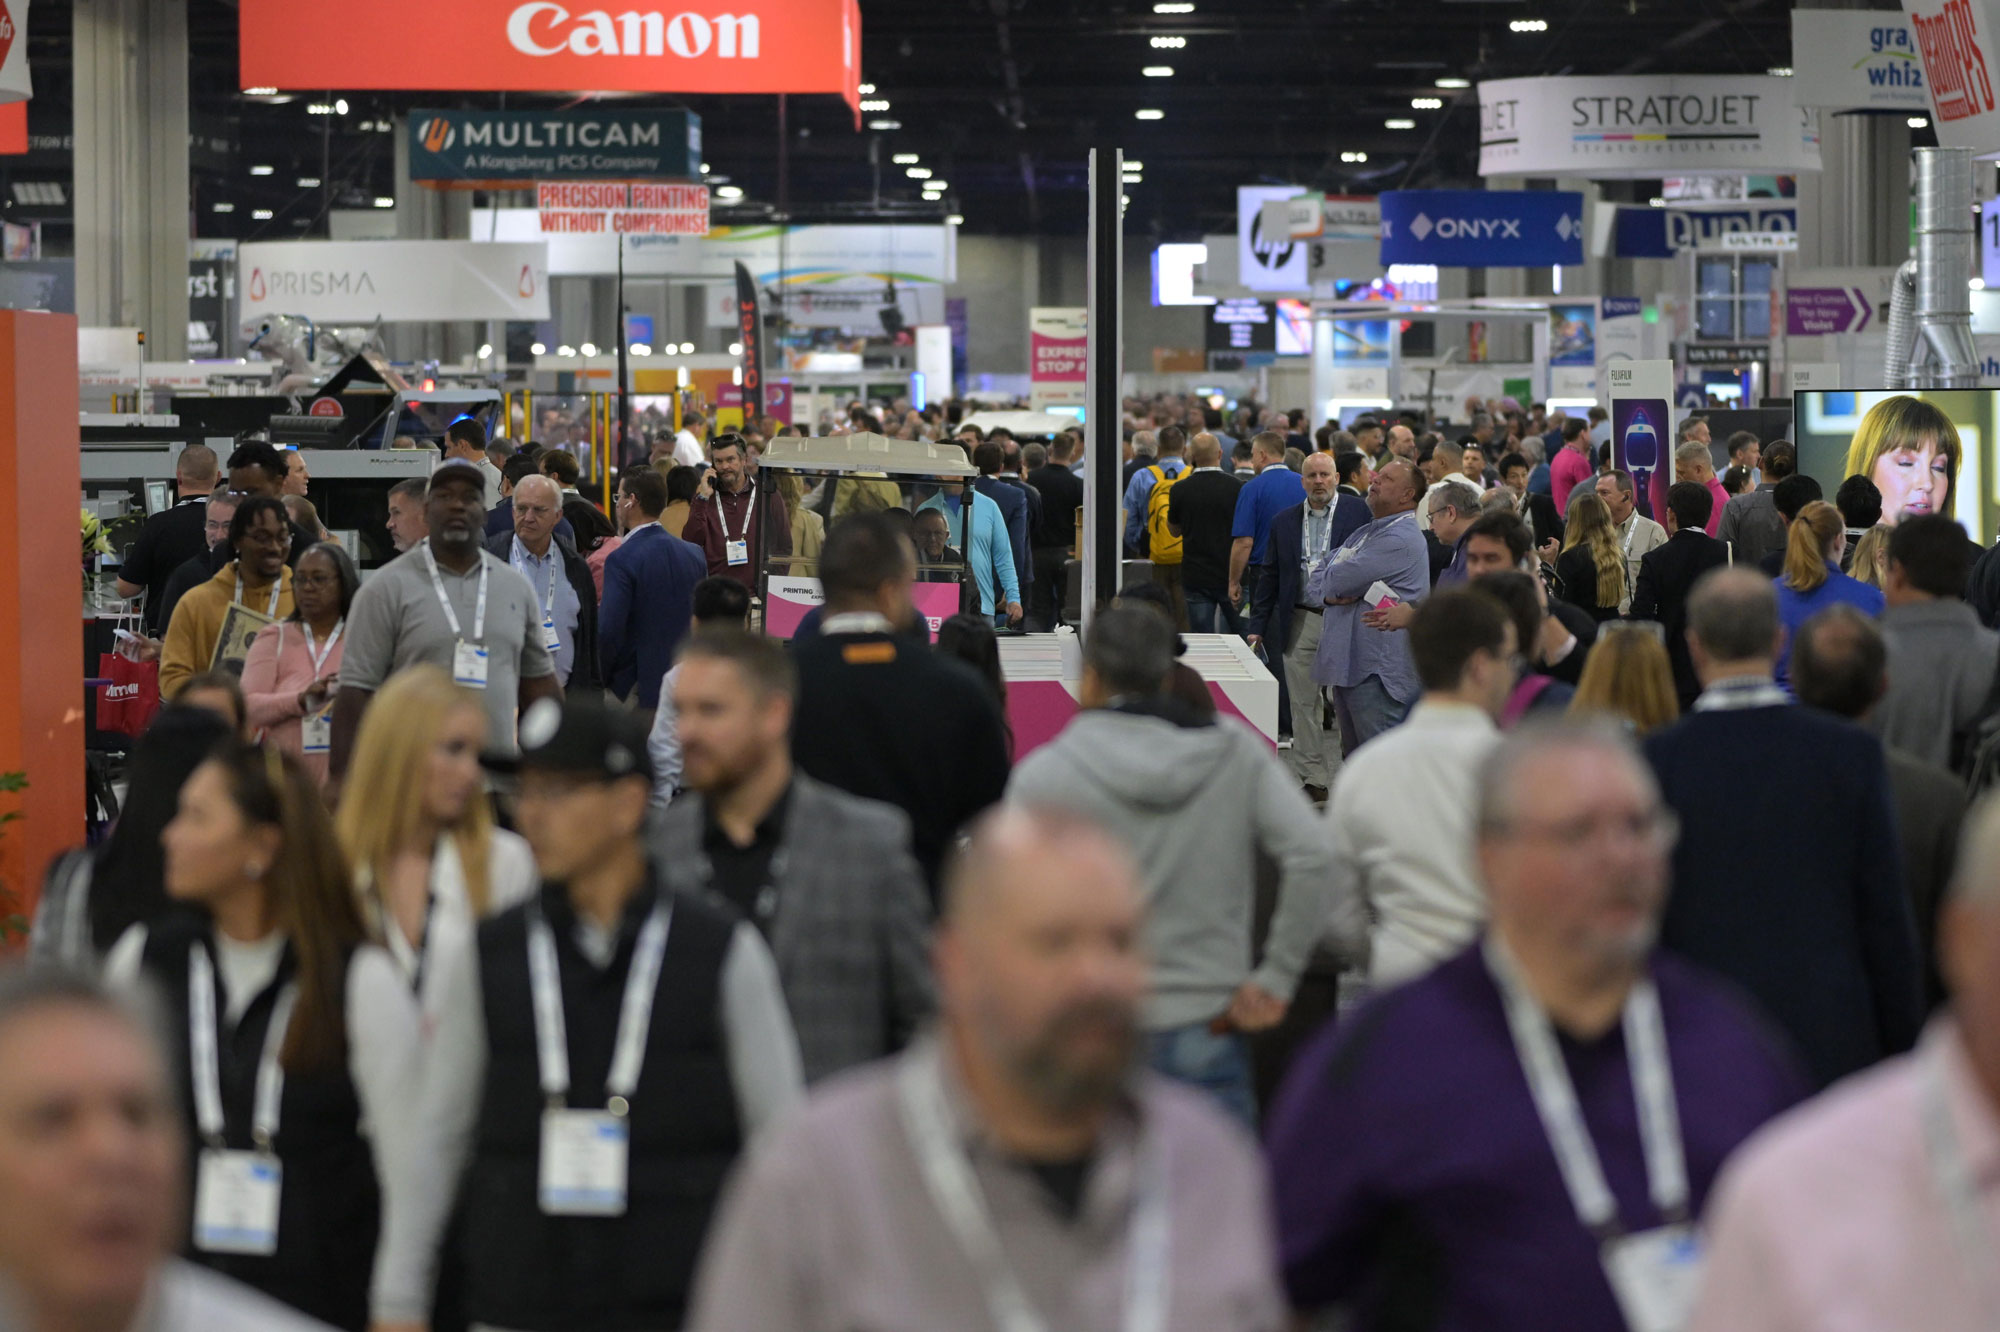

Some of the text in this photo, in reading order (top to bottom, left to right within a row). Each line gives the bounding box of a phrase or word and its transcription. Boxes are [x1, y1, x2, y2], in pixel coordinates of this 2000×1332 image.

[507, 1, 760, 59] Canon
[1868, 61, 1923, 87] whiz
[1573, 95, 1761, 127] STRATOJET
[464, 122, 660, 148] MULTICAM
[465, 155, 660, 172] A Kongsberg PCS Company
[539, 185, 708, 208] PRECISION PRINTING
[540, 212, 708, 233] WITHOUT COMPROMISE
[1436, 218, 1521, 240] ONYX
[270, 271, 376, 296] PRISMA
[1037, 361, 1075, 373] STOP
[1611, 369, 1632, 380] FUJIFILM
[783, 587, 814, 595] PRINTING
